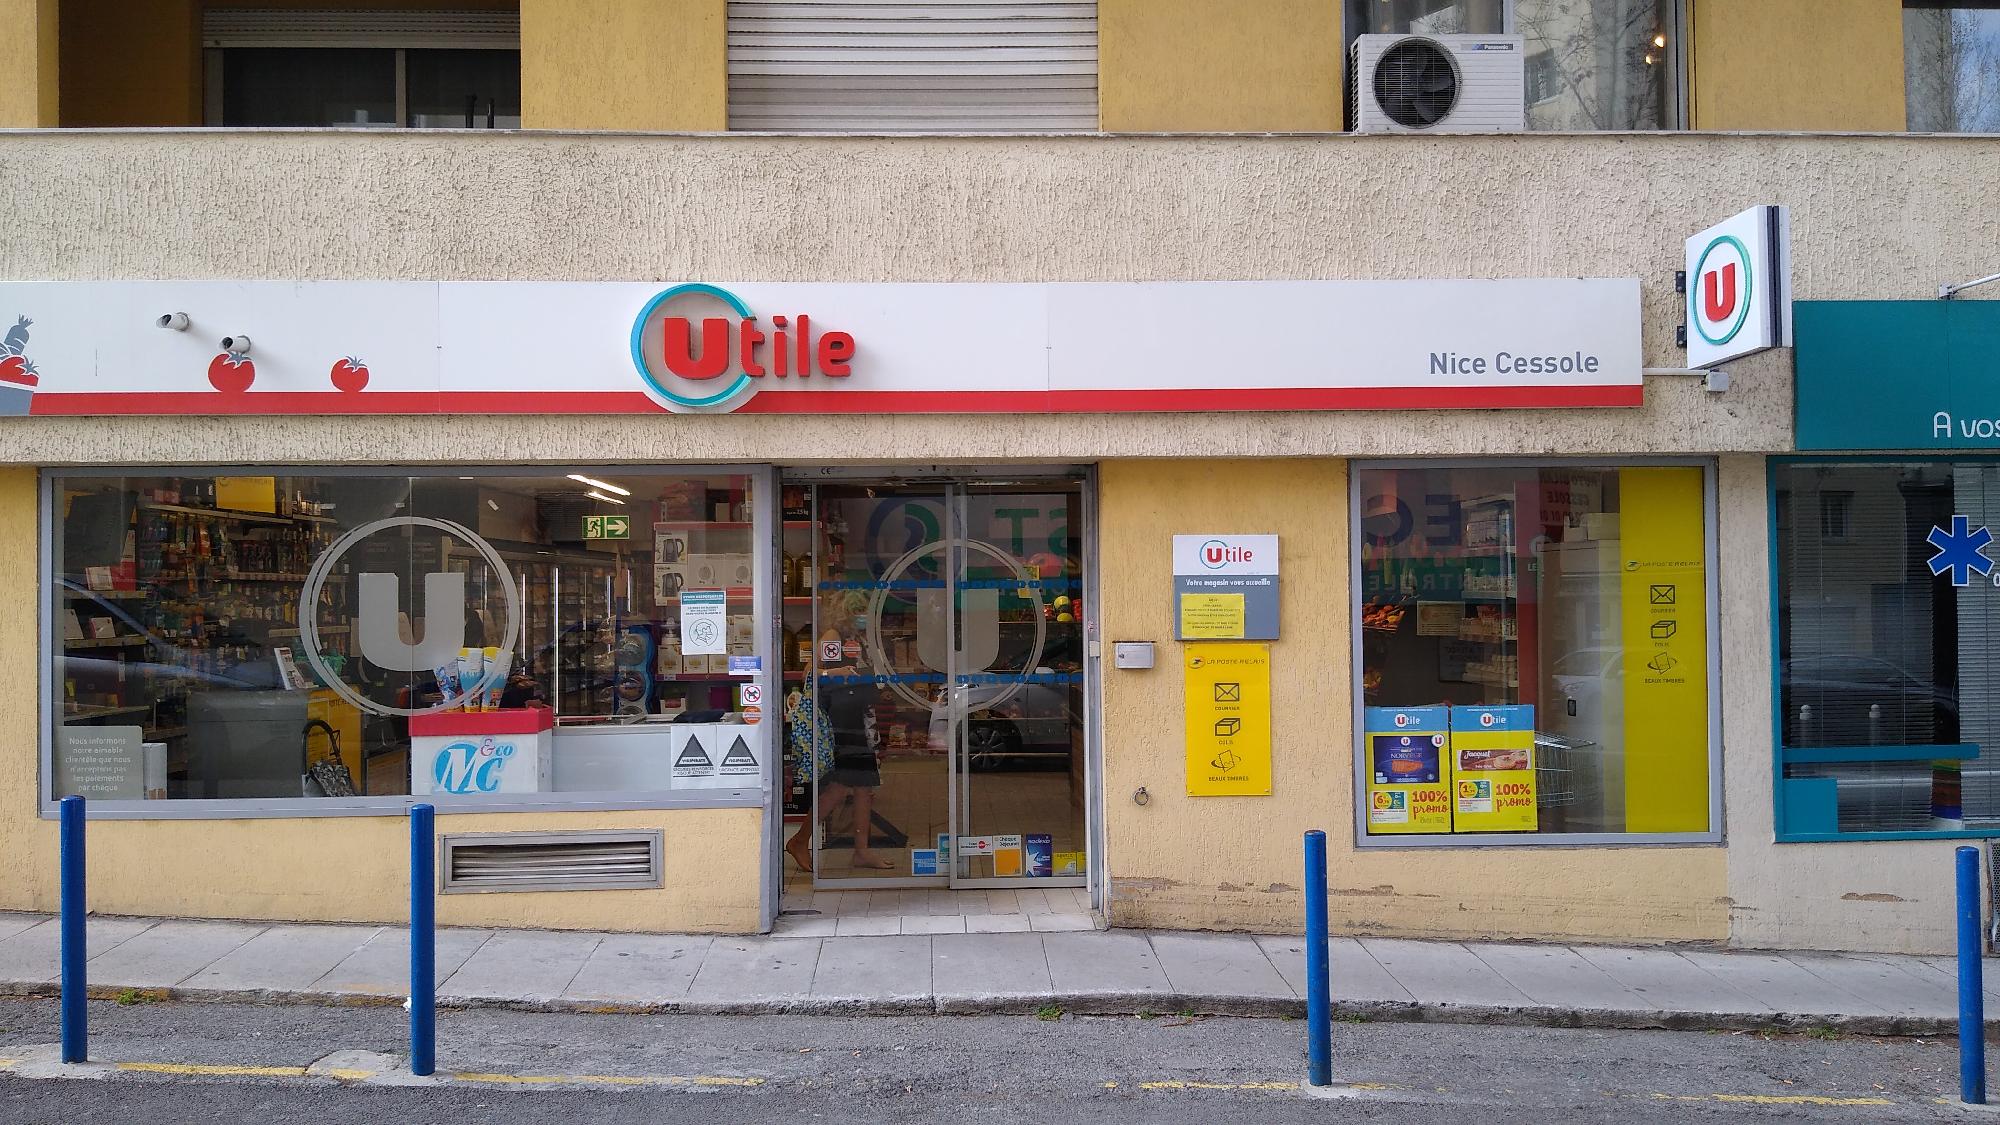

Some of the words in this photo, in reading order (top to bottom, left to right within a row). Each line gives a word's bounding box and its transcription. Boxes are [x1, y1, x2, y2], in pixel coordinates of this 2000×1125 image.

[1704, 263, 1736, 322] U
[664, 315, 856, 380] Utile
[1430, 352, 1487, 375] Nice
[1495, 351, 1599, 374] Cessole
[1206, 547, 1253, 563] Utile
[1185, 578, 1203, 586] Votre
[1204, 578, 1229, 588] magasin
[1245, 577, 1271, 586] accueille
[359, 572, 464, 672] U
[1397, 715, 1421, 725] Utile
[1482, 715, 1507, 724] Utile
[1412, 790, 1448, 803] 100%
[1495, 783, 1531, 796] 100%
[1413, 804, 1449, 820] promo
[1496, 797, 1533, 813] promo
